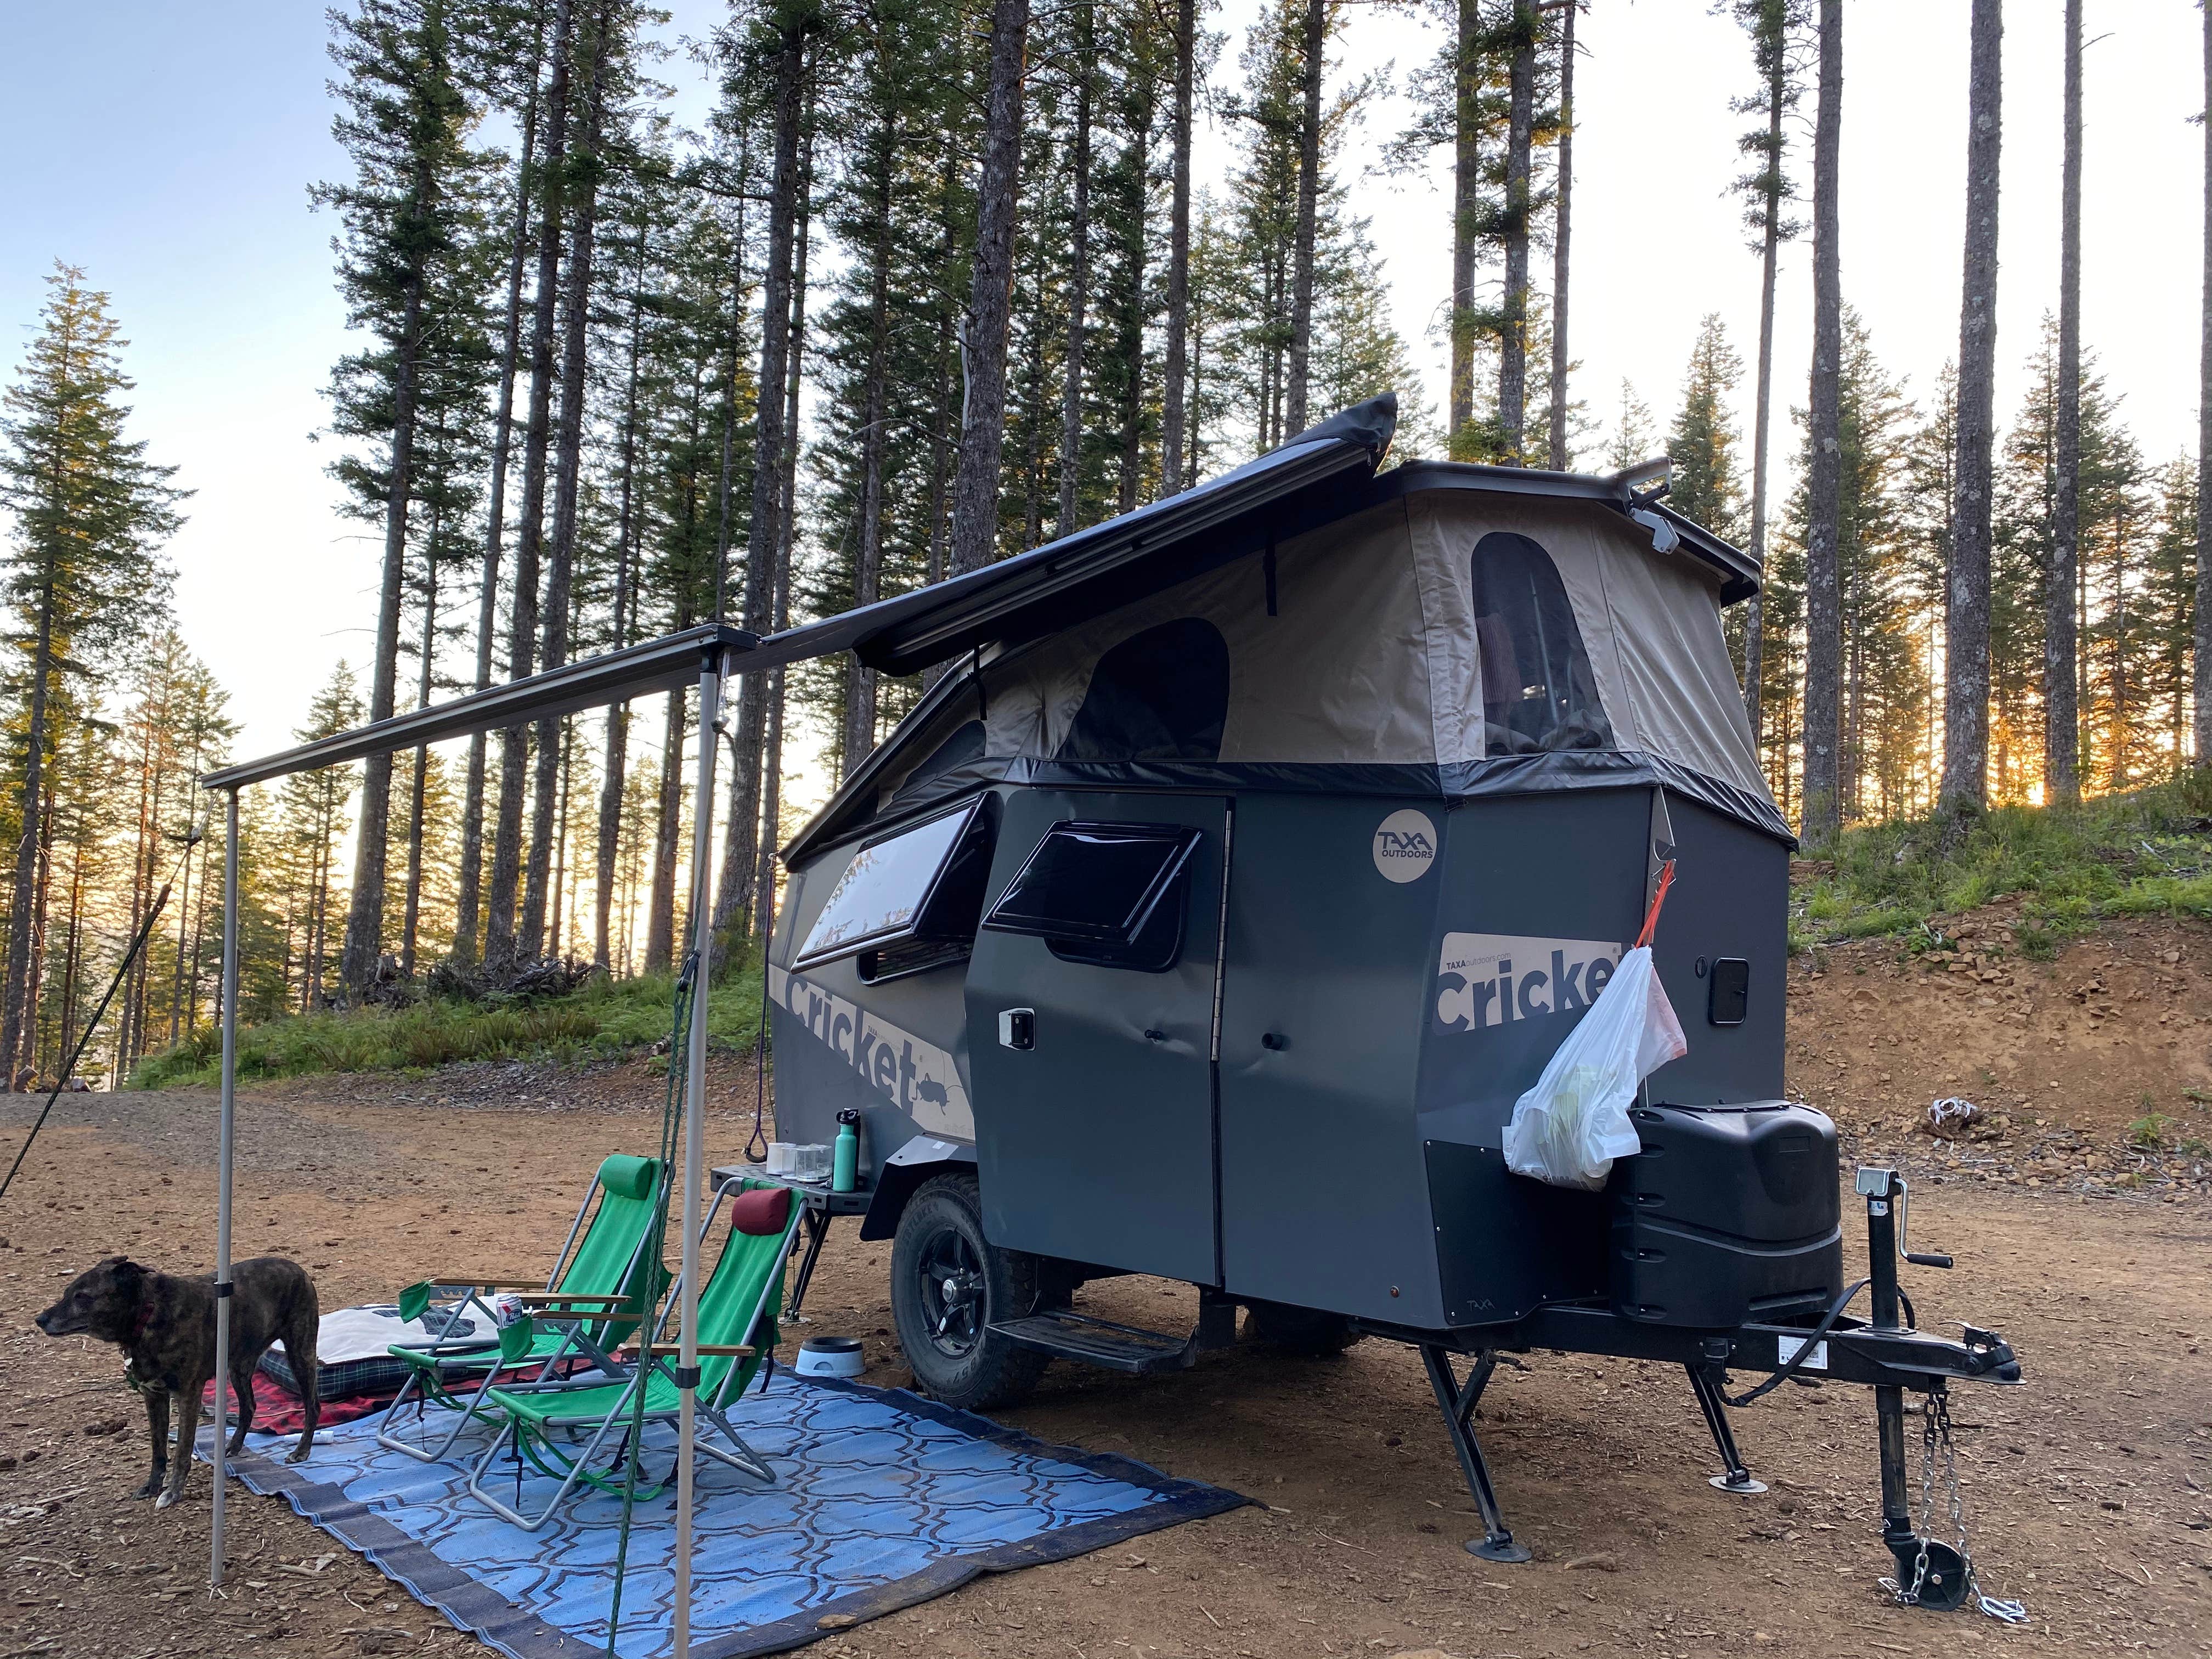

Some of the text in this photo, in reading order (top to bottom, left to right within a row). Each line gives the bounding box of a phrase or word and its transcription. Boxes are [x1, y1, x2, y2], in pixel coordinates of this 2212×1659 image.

[1378, 832, 1433, 850] TAXA
[1382, 850, 1433, 858] OUTDOORS
[1432, 950, 1623, 1036] Cricke
[1466, 1299, 1495, 1312] TAXA
